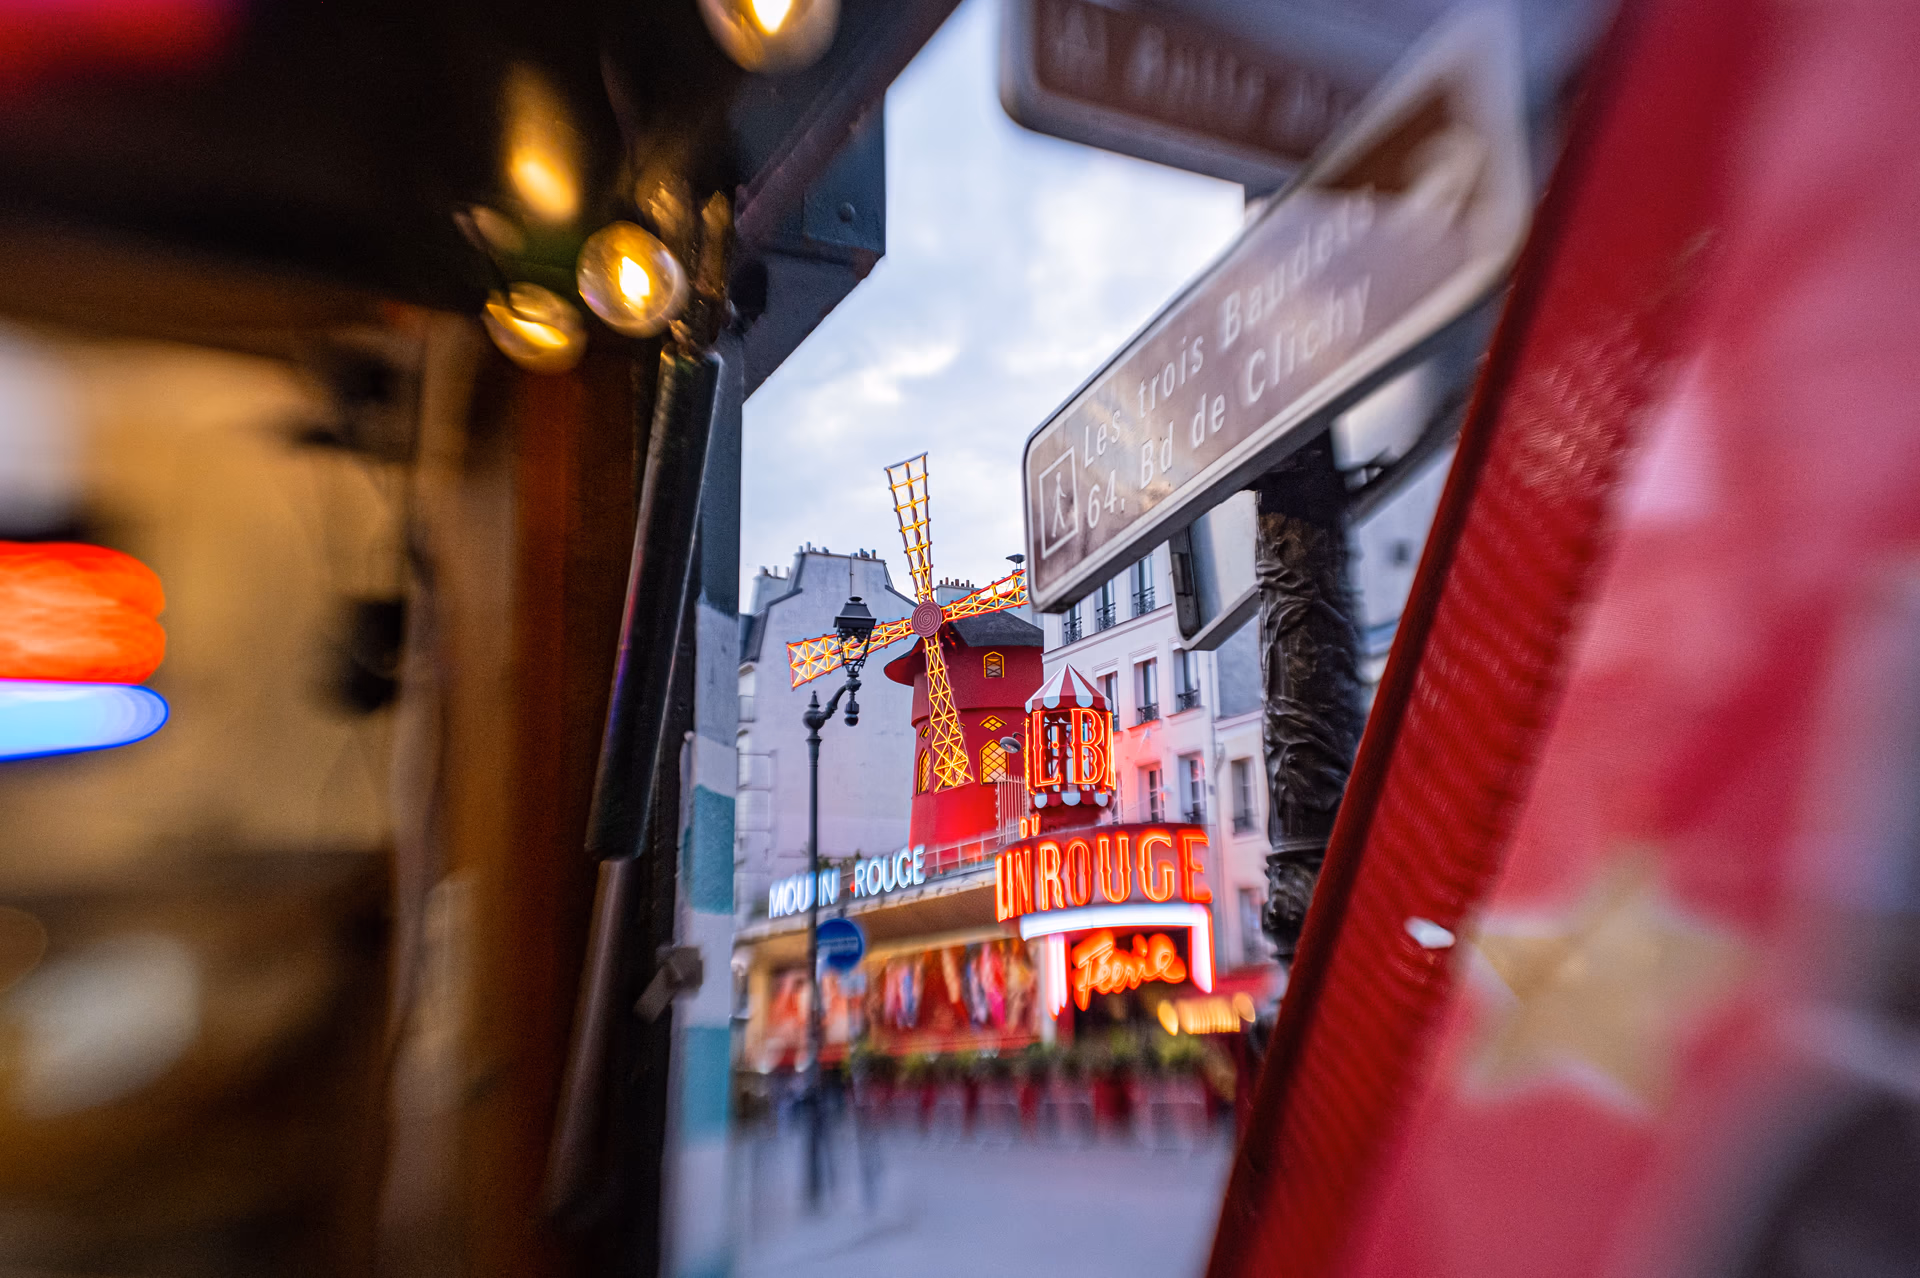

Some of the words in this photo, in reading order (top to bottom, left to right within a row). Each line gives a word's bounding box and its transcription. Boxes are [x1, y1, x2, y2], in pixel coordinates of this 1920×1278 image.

[1084, 410, 1121, 468] Les
[1138, 335, 1204, 418] trois
[1141, 420, 1174, 490] Bd
[1193, 393, 1225, 449] de
[1246, 273, 1371, 404] Clichy
[769, 867, 841, 919] MOUIN
[854, 844, 925, 898] ROUGE
[1037, 828, 1213, 910] ROUGE
